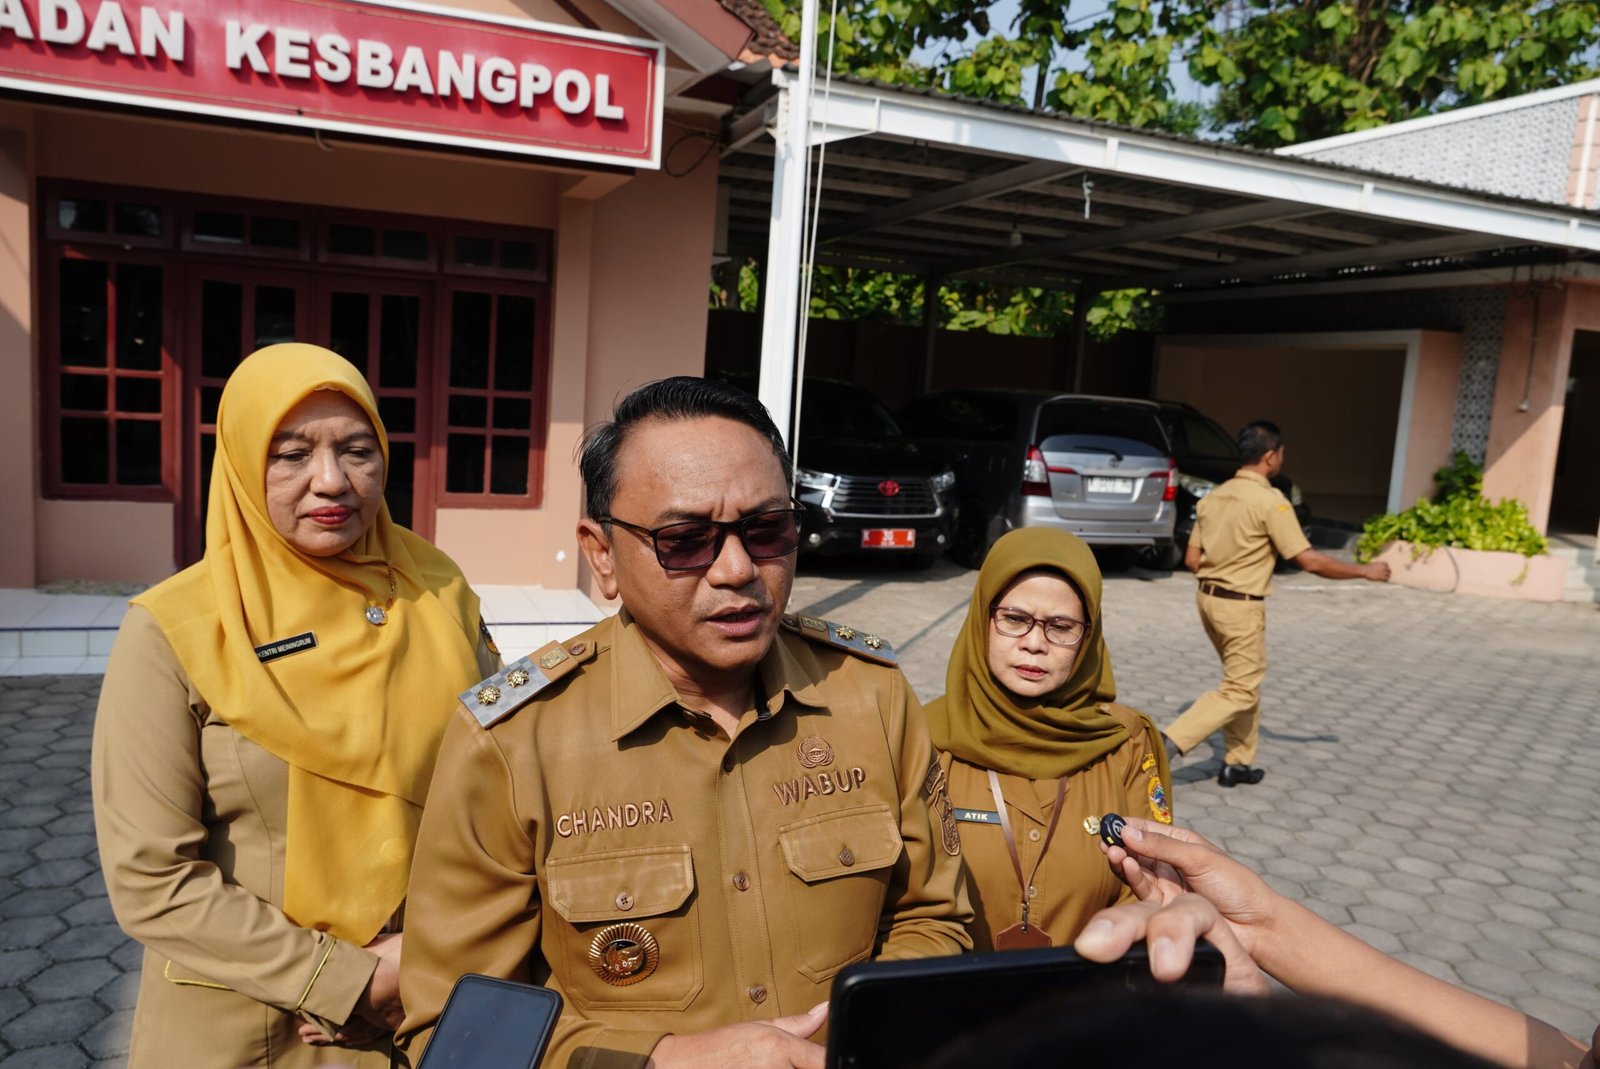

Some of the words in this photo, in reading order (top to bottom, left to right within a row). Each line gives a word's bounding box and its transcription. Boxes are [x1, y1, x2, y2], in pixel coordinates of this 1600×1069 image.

[226, 20, 625, 119] KESBANGPOL
[772, 767, 866, 806] WABUP
[556, 798, 674, 838] CHANDRA
[964, 811, 988, 821] ATIK
